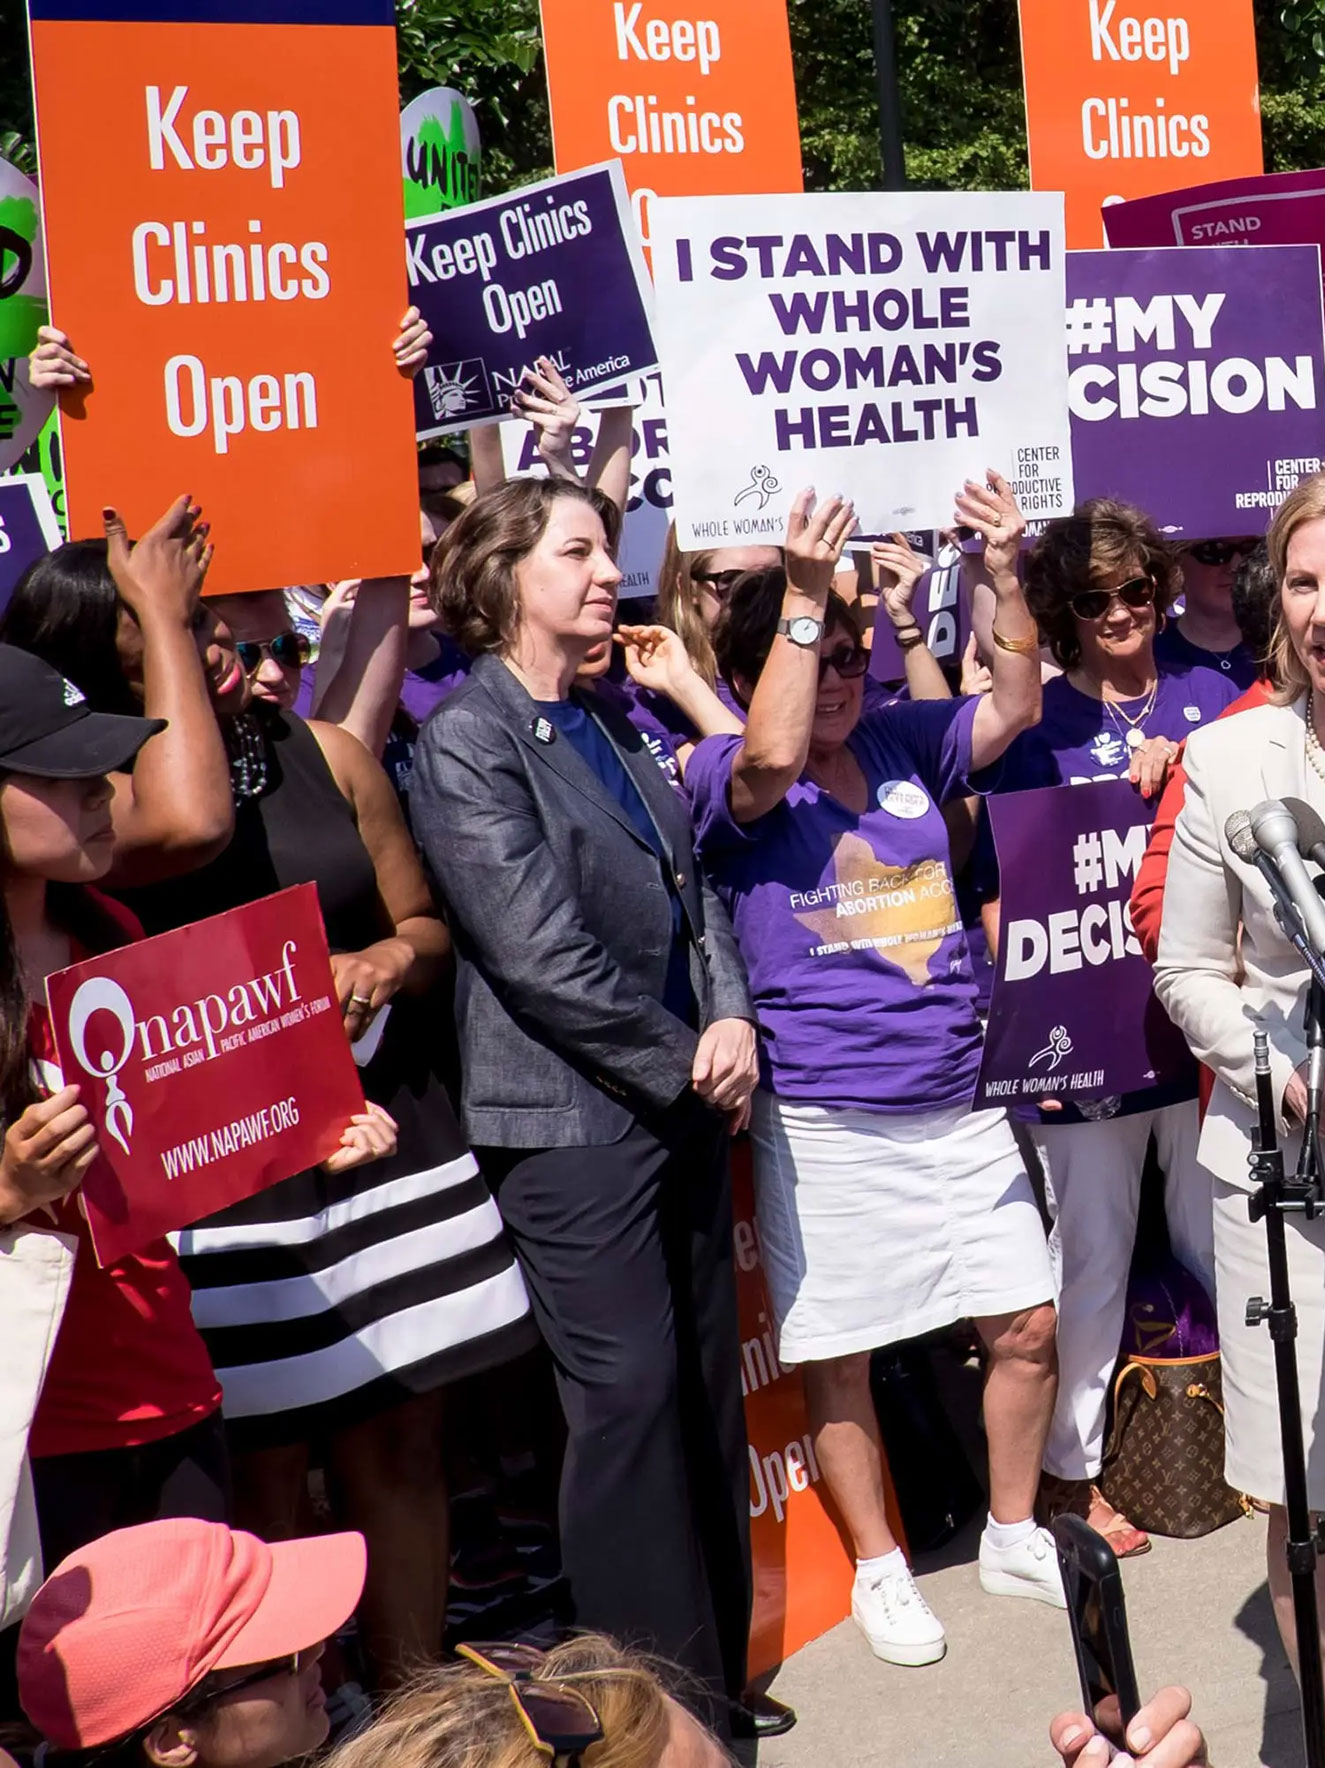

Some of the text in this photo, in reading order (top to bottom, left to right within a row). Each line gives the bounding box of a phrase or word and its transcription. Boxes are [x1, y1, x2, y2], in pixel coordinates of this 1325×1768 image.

[616, 3, 720, 74] Keep
[1088, 0, 1190, 75] Keep
[144, 85, 301, 188] Keep
[608, 95, 744, 154] Clinics
[1081, 97, 1210, 160] Clinics
[405, 231, 497, 287] Keep
[499, 196, 592, 260] Clinics
[1191, 217, 1262, 239] STAND
[132, 220, 331, 305] Clinics
[675, 230, 1051, 282] I STAND WITH
[482, 278, 562, 339] Open
[768, 286, 971, 336] WHOLE
[1065, 293, 1226, 354] #MY
[576, 354, 631, 385] America
[735, 340, 1002, 395] WOMAN'S
[164, 354, 317, 454] Open
[775, 398, 979, 451] HEALTH
[1017, 446, 1060, 463] CENTER
[1019, 463, 1039, 478] FOR
[1275, 458, 1320, 475] CENTER
[1021, 493, 1063, 510] RIGHTS
[1276, 475, 1299, 490] FOR
[691, 521, 729, 538] WHOLE
[733, 517, 784, 536] WOMAN'S
[617, 572, 650, 588] EALTH
[789, 861, 947, 909] FIGHTING BACK FOR
[1073, 824, 1153, 895] #M
[835, 890, 916, 919] ABORTION
[135, 940, 302, 1061] napawf
[145, 1059, 182, 1083] NATIONAL
[183, 1049, 205, 1069] ASIAN
[220, 1031, 247, 1053] PACIFIC
[248, 1020, 280, 1043] AMERICAN
[281, 1003, 311, 1028] WOMEN'S
[985, 1069, 1104, 1098] WHOLE WOMAN'S HEALTH
[161, 1096, 299, 1181] WWW.NAPAWF.ORG
